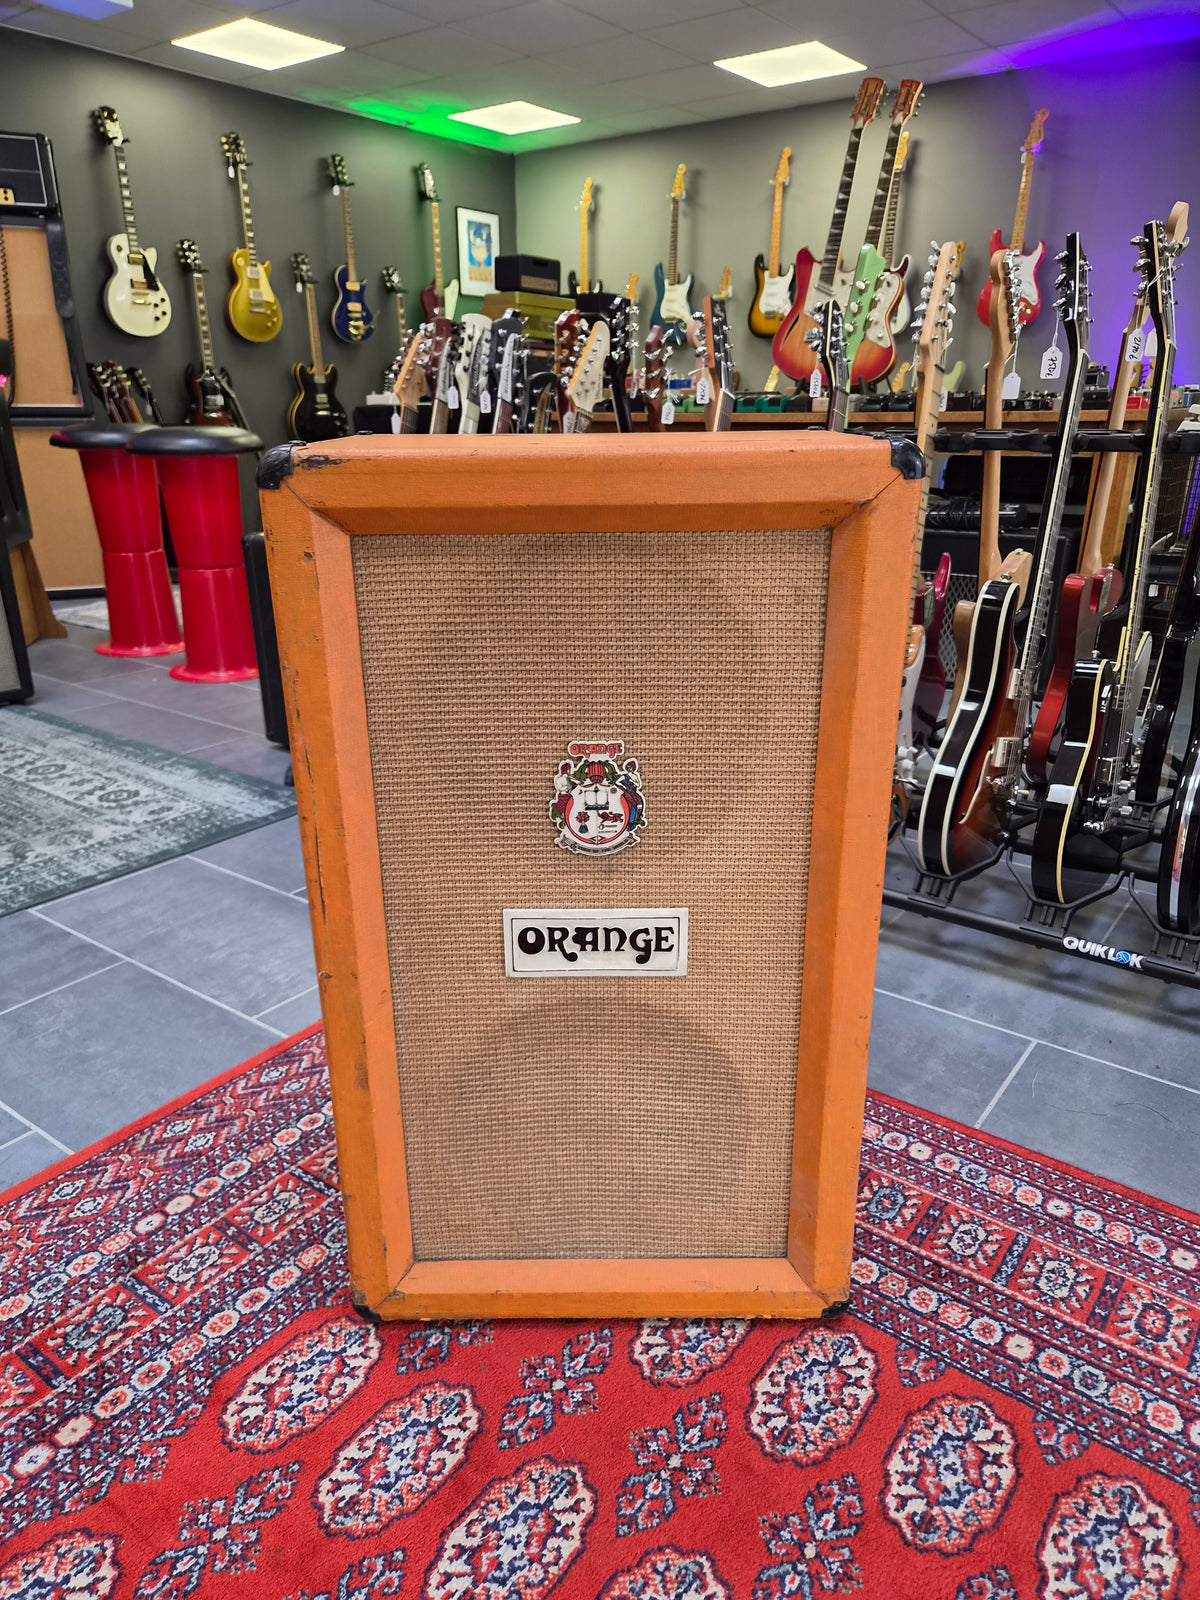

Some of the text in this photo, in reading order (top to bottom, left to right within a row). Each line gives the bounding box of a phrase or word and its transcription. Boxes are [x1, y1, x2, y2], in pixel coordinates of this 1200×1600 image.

[1045, 355, 1058, 377] 750€
[569, 743, 623, 758] ORANGE
[517, 926, 675, 965] ORANGE
